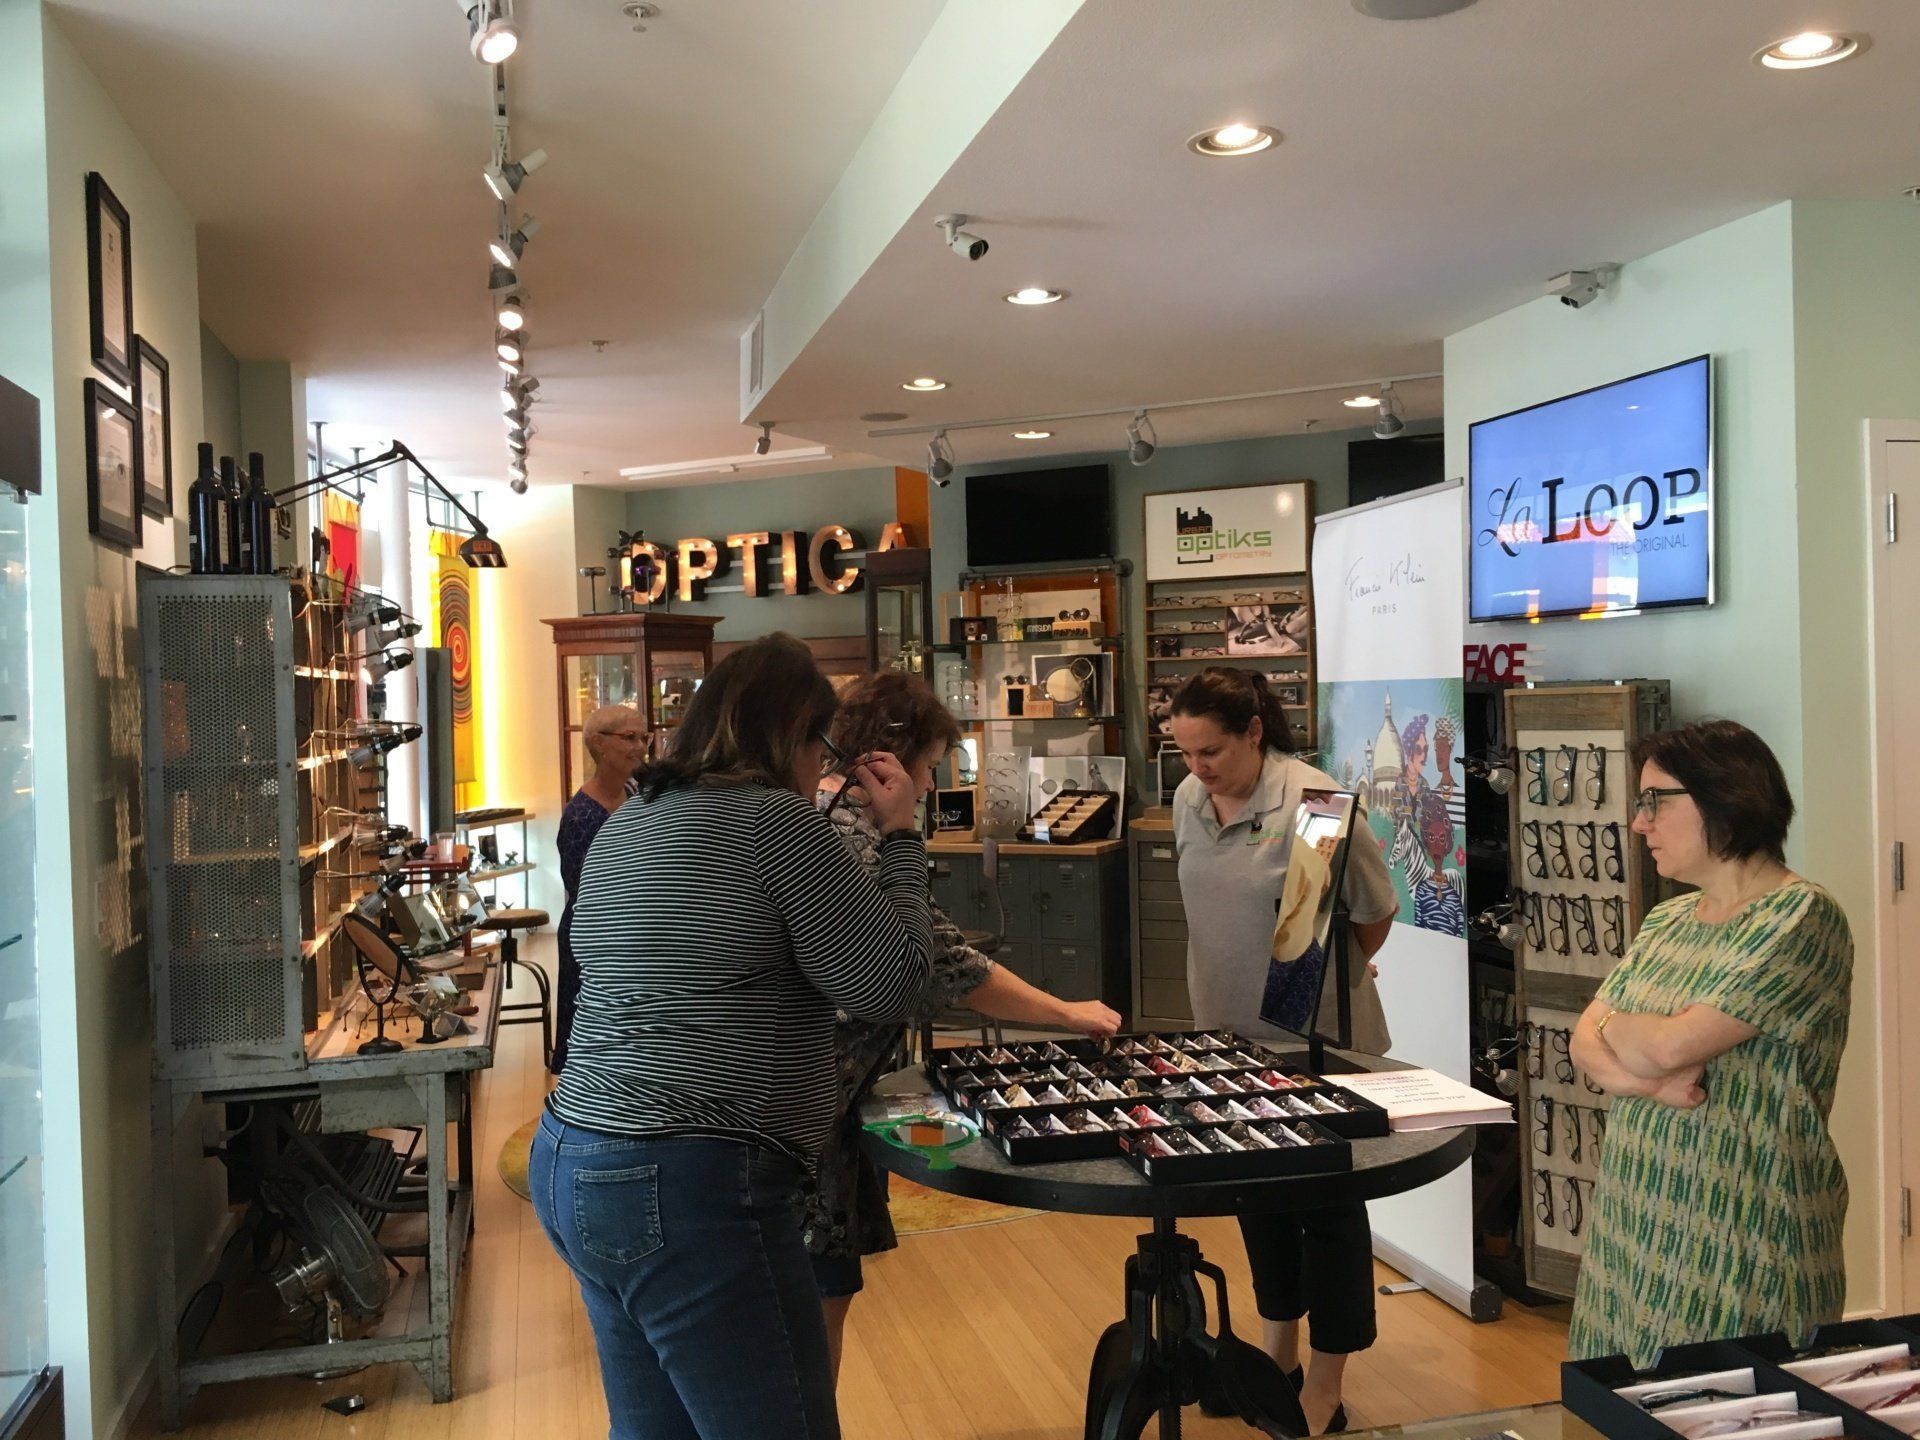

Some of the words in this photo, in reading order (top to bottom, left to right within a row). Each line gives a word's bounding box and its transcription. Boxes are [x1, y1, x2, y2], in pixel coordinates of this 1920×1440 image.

[1542, 467, 1701, 544] LOOP
[1177, 529, 1272, 555] optiks
[1635, 532, 1689, 554] ORIGINAL
[1371, 604, 1398, 615] PARIS
[1463, 643, 1527, 683] FACE
